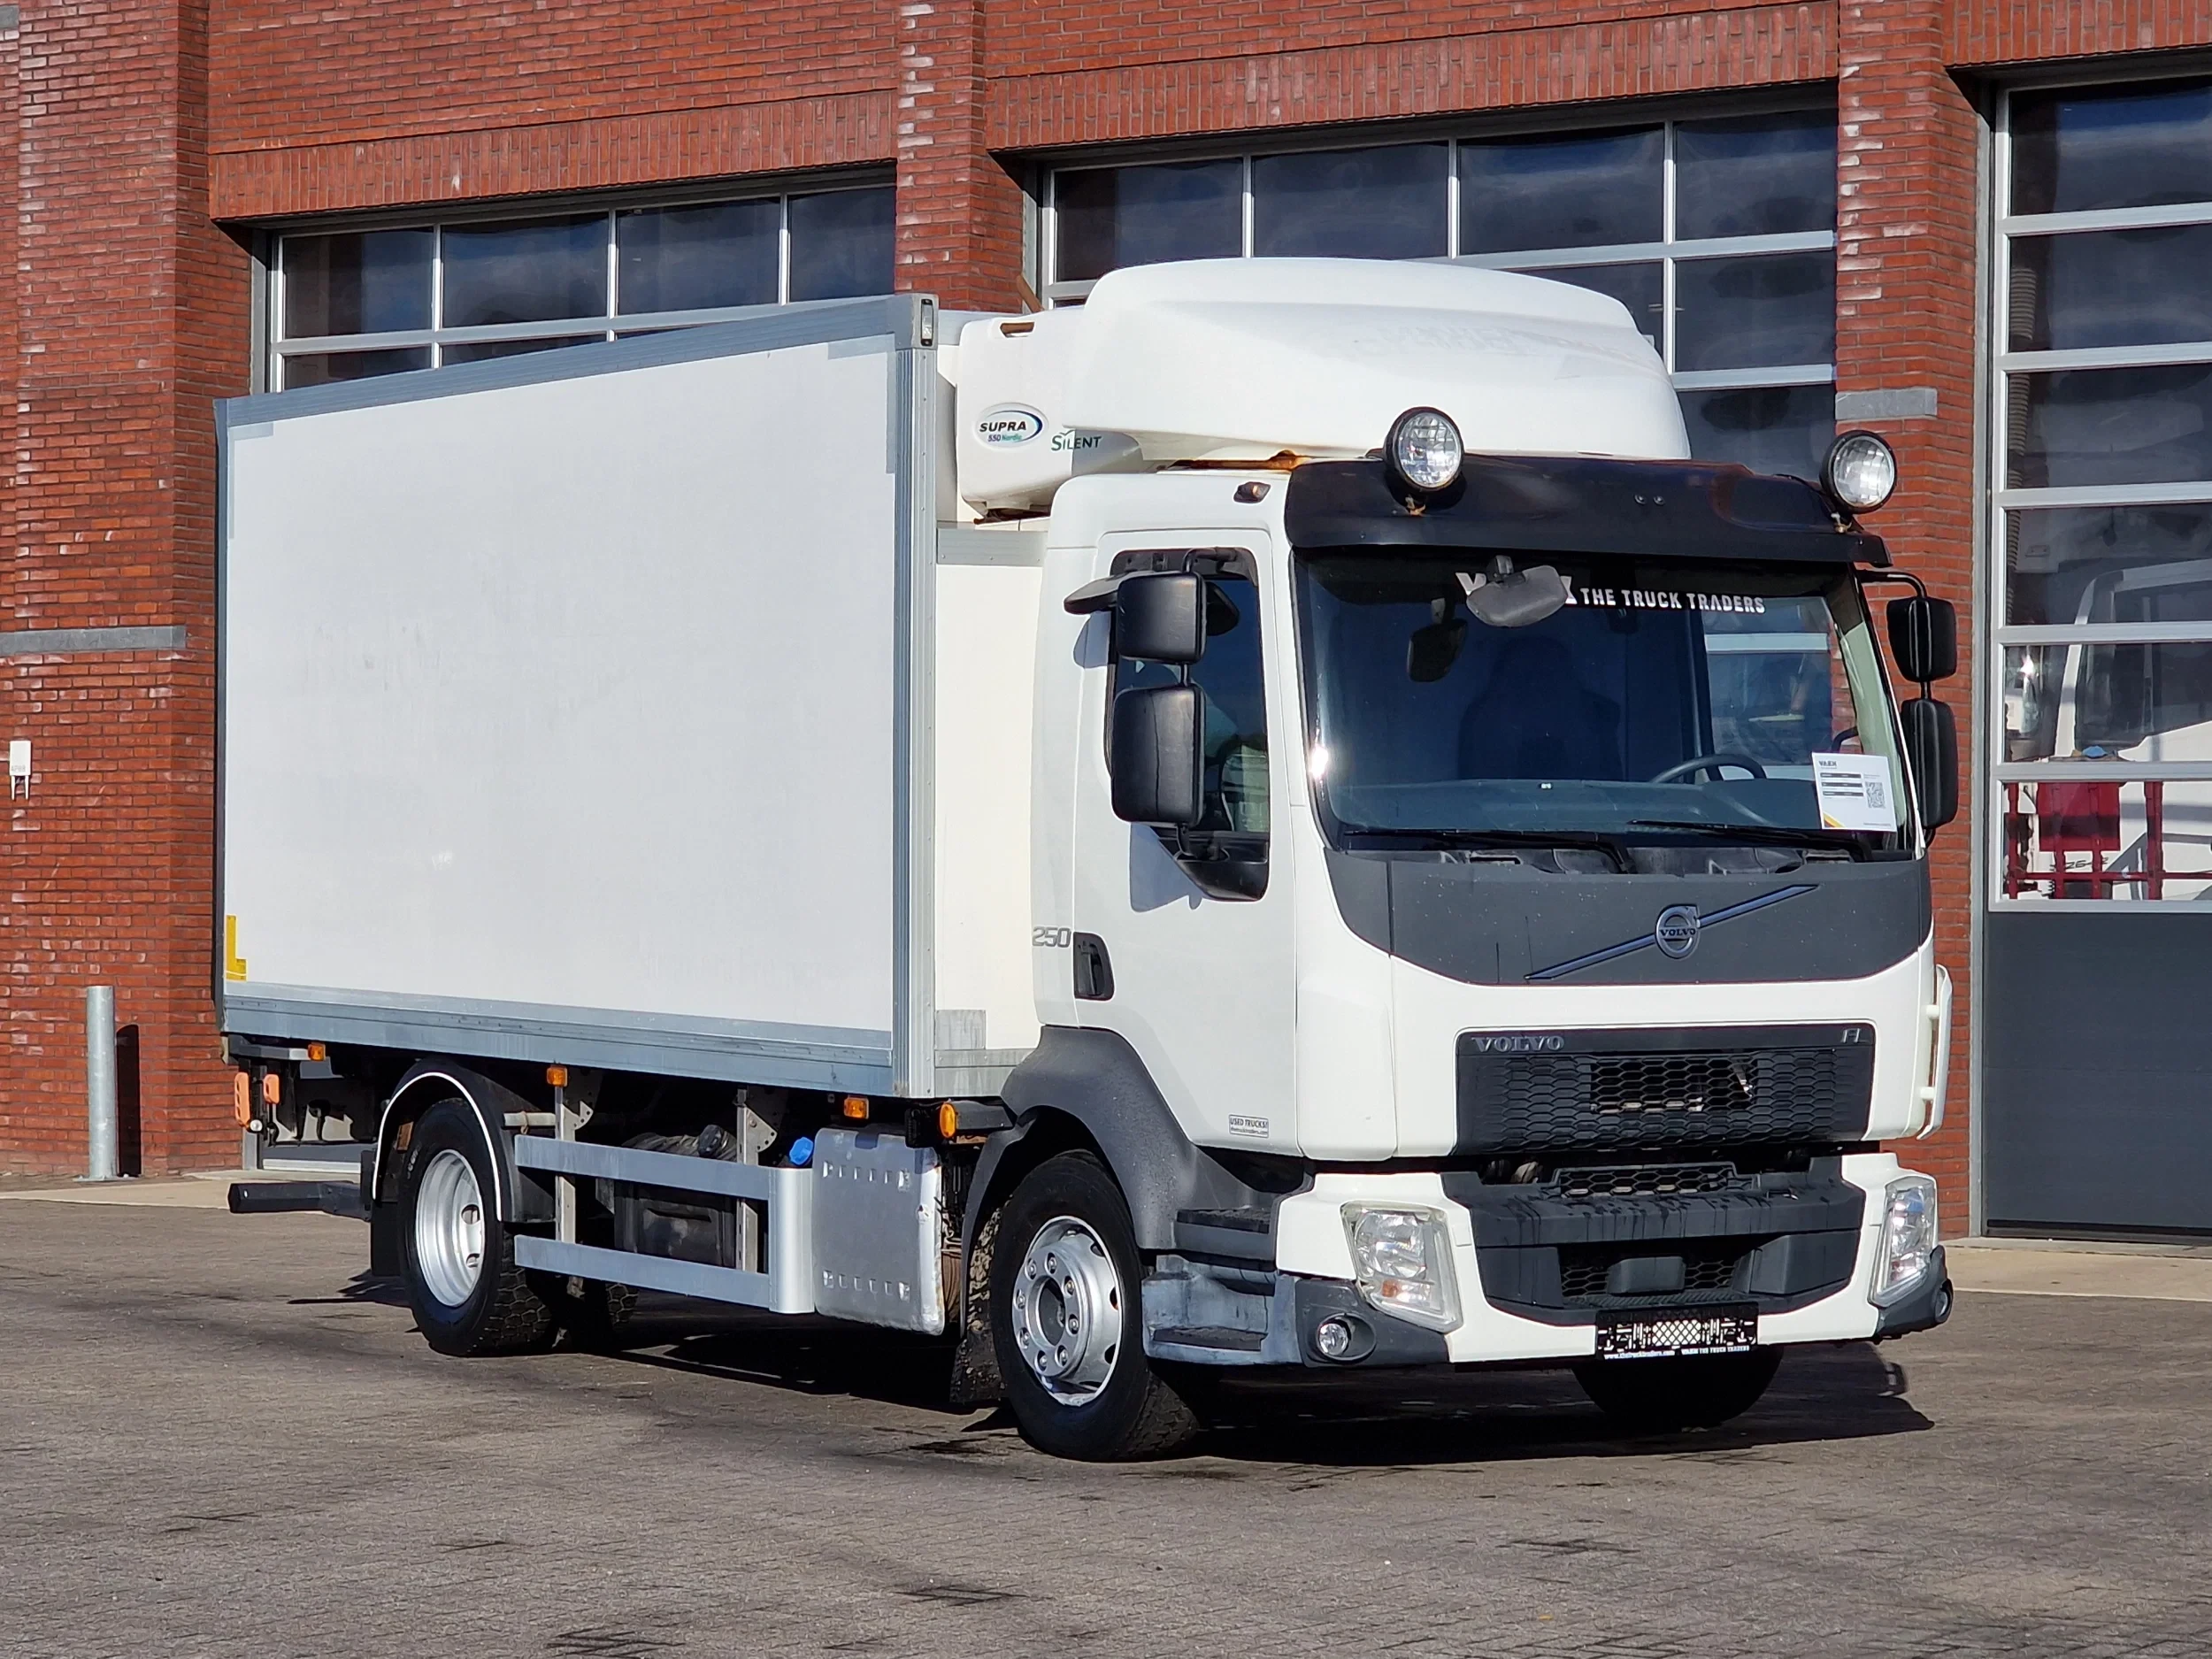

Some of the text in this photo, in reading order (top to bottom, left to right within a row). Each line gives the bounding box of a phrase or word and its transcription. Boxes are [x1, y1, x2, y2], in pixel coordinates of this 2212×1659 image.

[979, 420, 1027, 434] SUPRA
[987, 434, 1002, 442] 550
[1579, 587, 1617, 606] THE
[1621, 588, 1683, 609] TRUCK
[1686, 593, 1766, 614] TRADERS
[1032, 926, 1071, 948] 250
[1471, 1034, 1564, 1053] VOLVO
[1840, 1027, 1870, 1044] FL
[1230, 1118, 1244, 1126] USED
